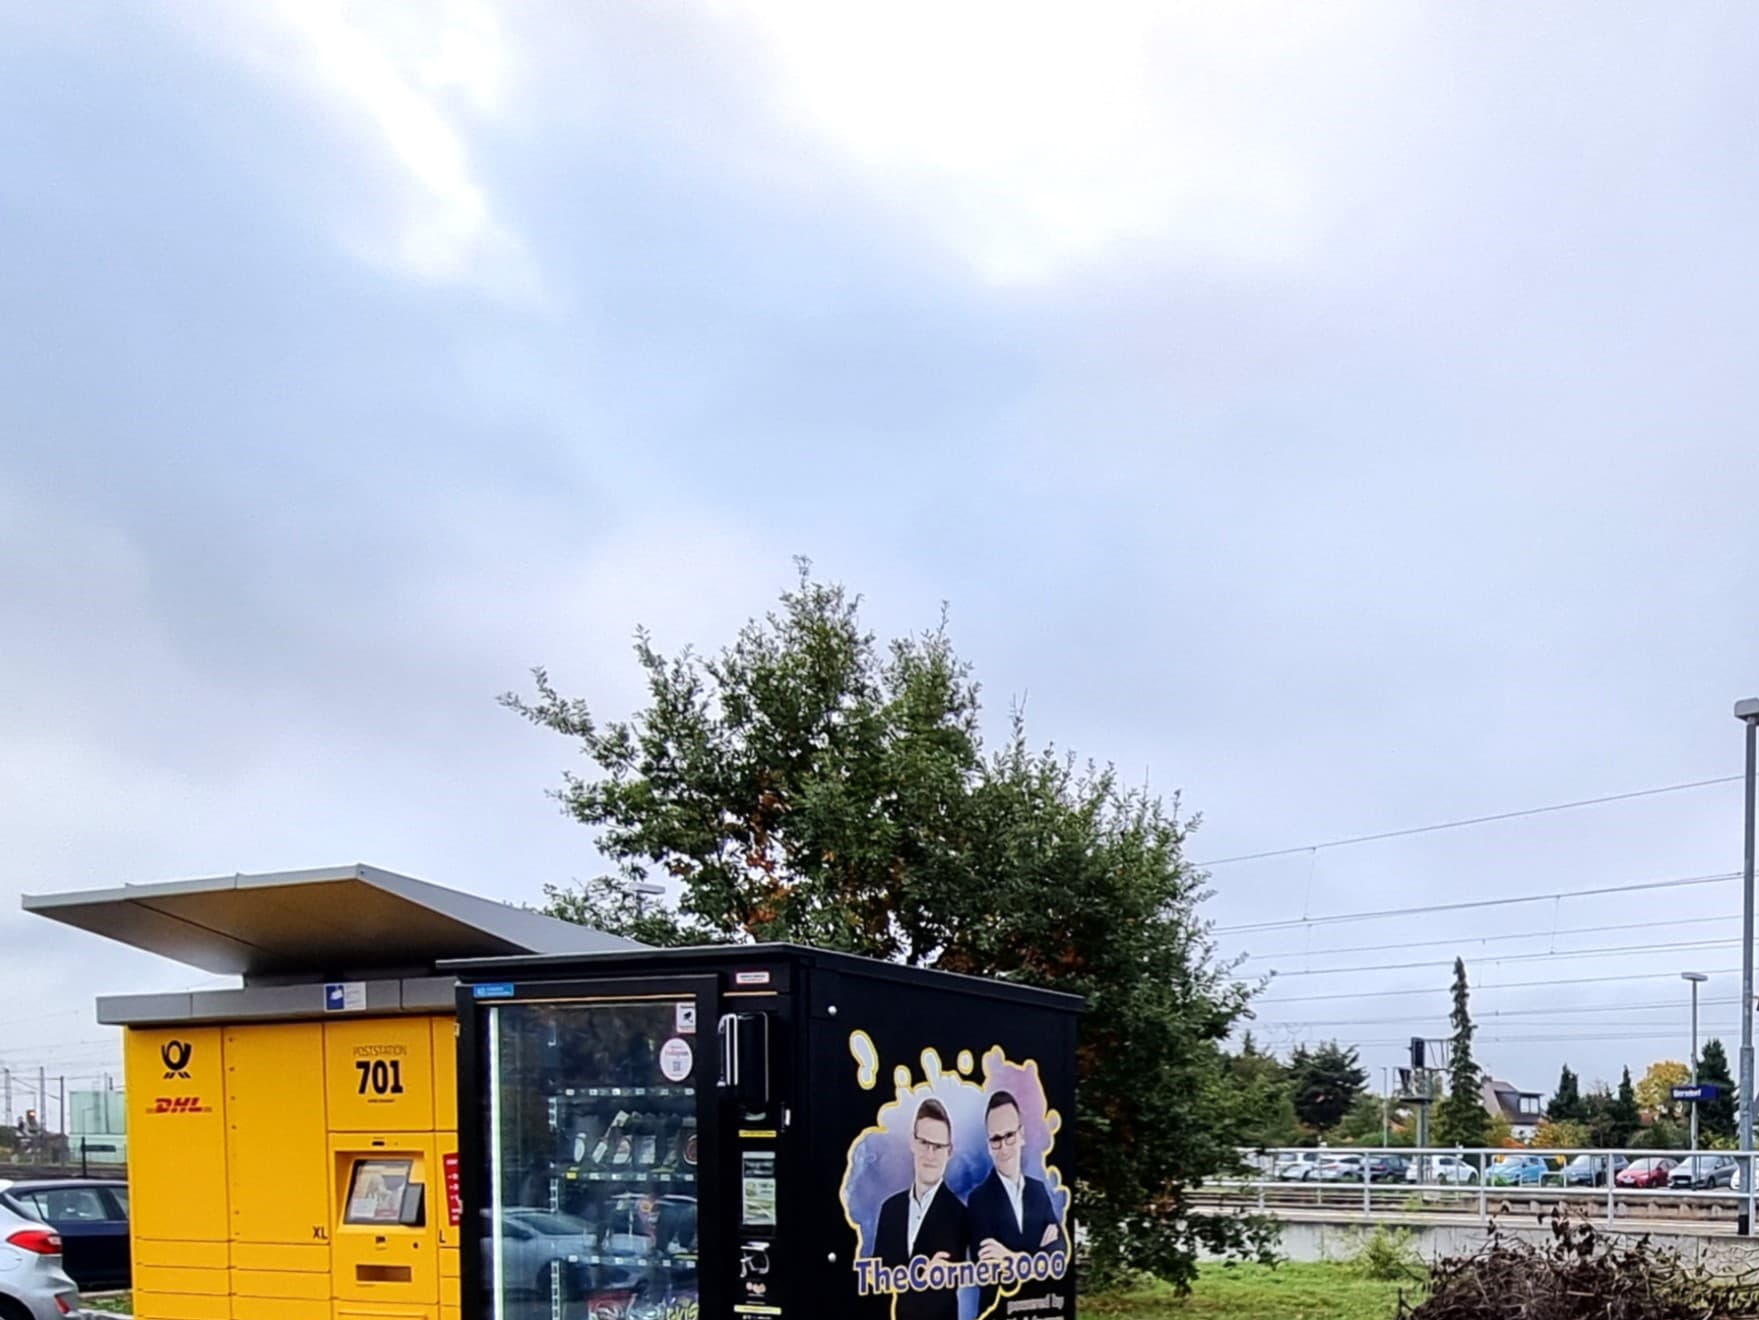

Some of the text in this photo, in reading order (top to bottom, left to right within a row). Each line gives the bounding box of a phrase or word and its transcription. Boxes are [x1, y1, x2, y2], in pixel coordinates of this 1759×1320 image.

[356, 1060, 403, 1094] 701
[155, 1097, 202, 1113] DHL
[313, 1226, 328, 1239] XL
[439, 1229, 446, 1243] L
[854, 1251, 1066, 1295] TheCorner3000
